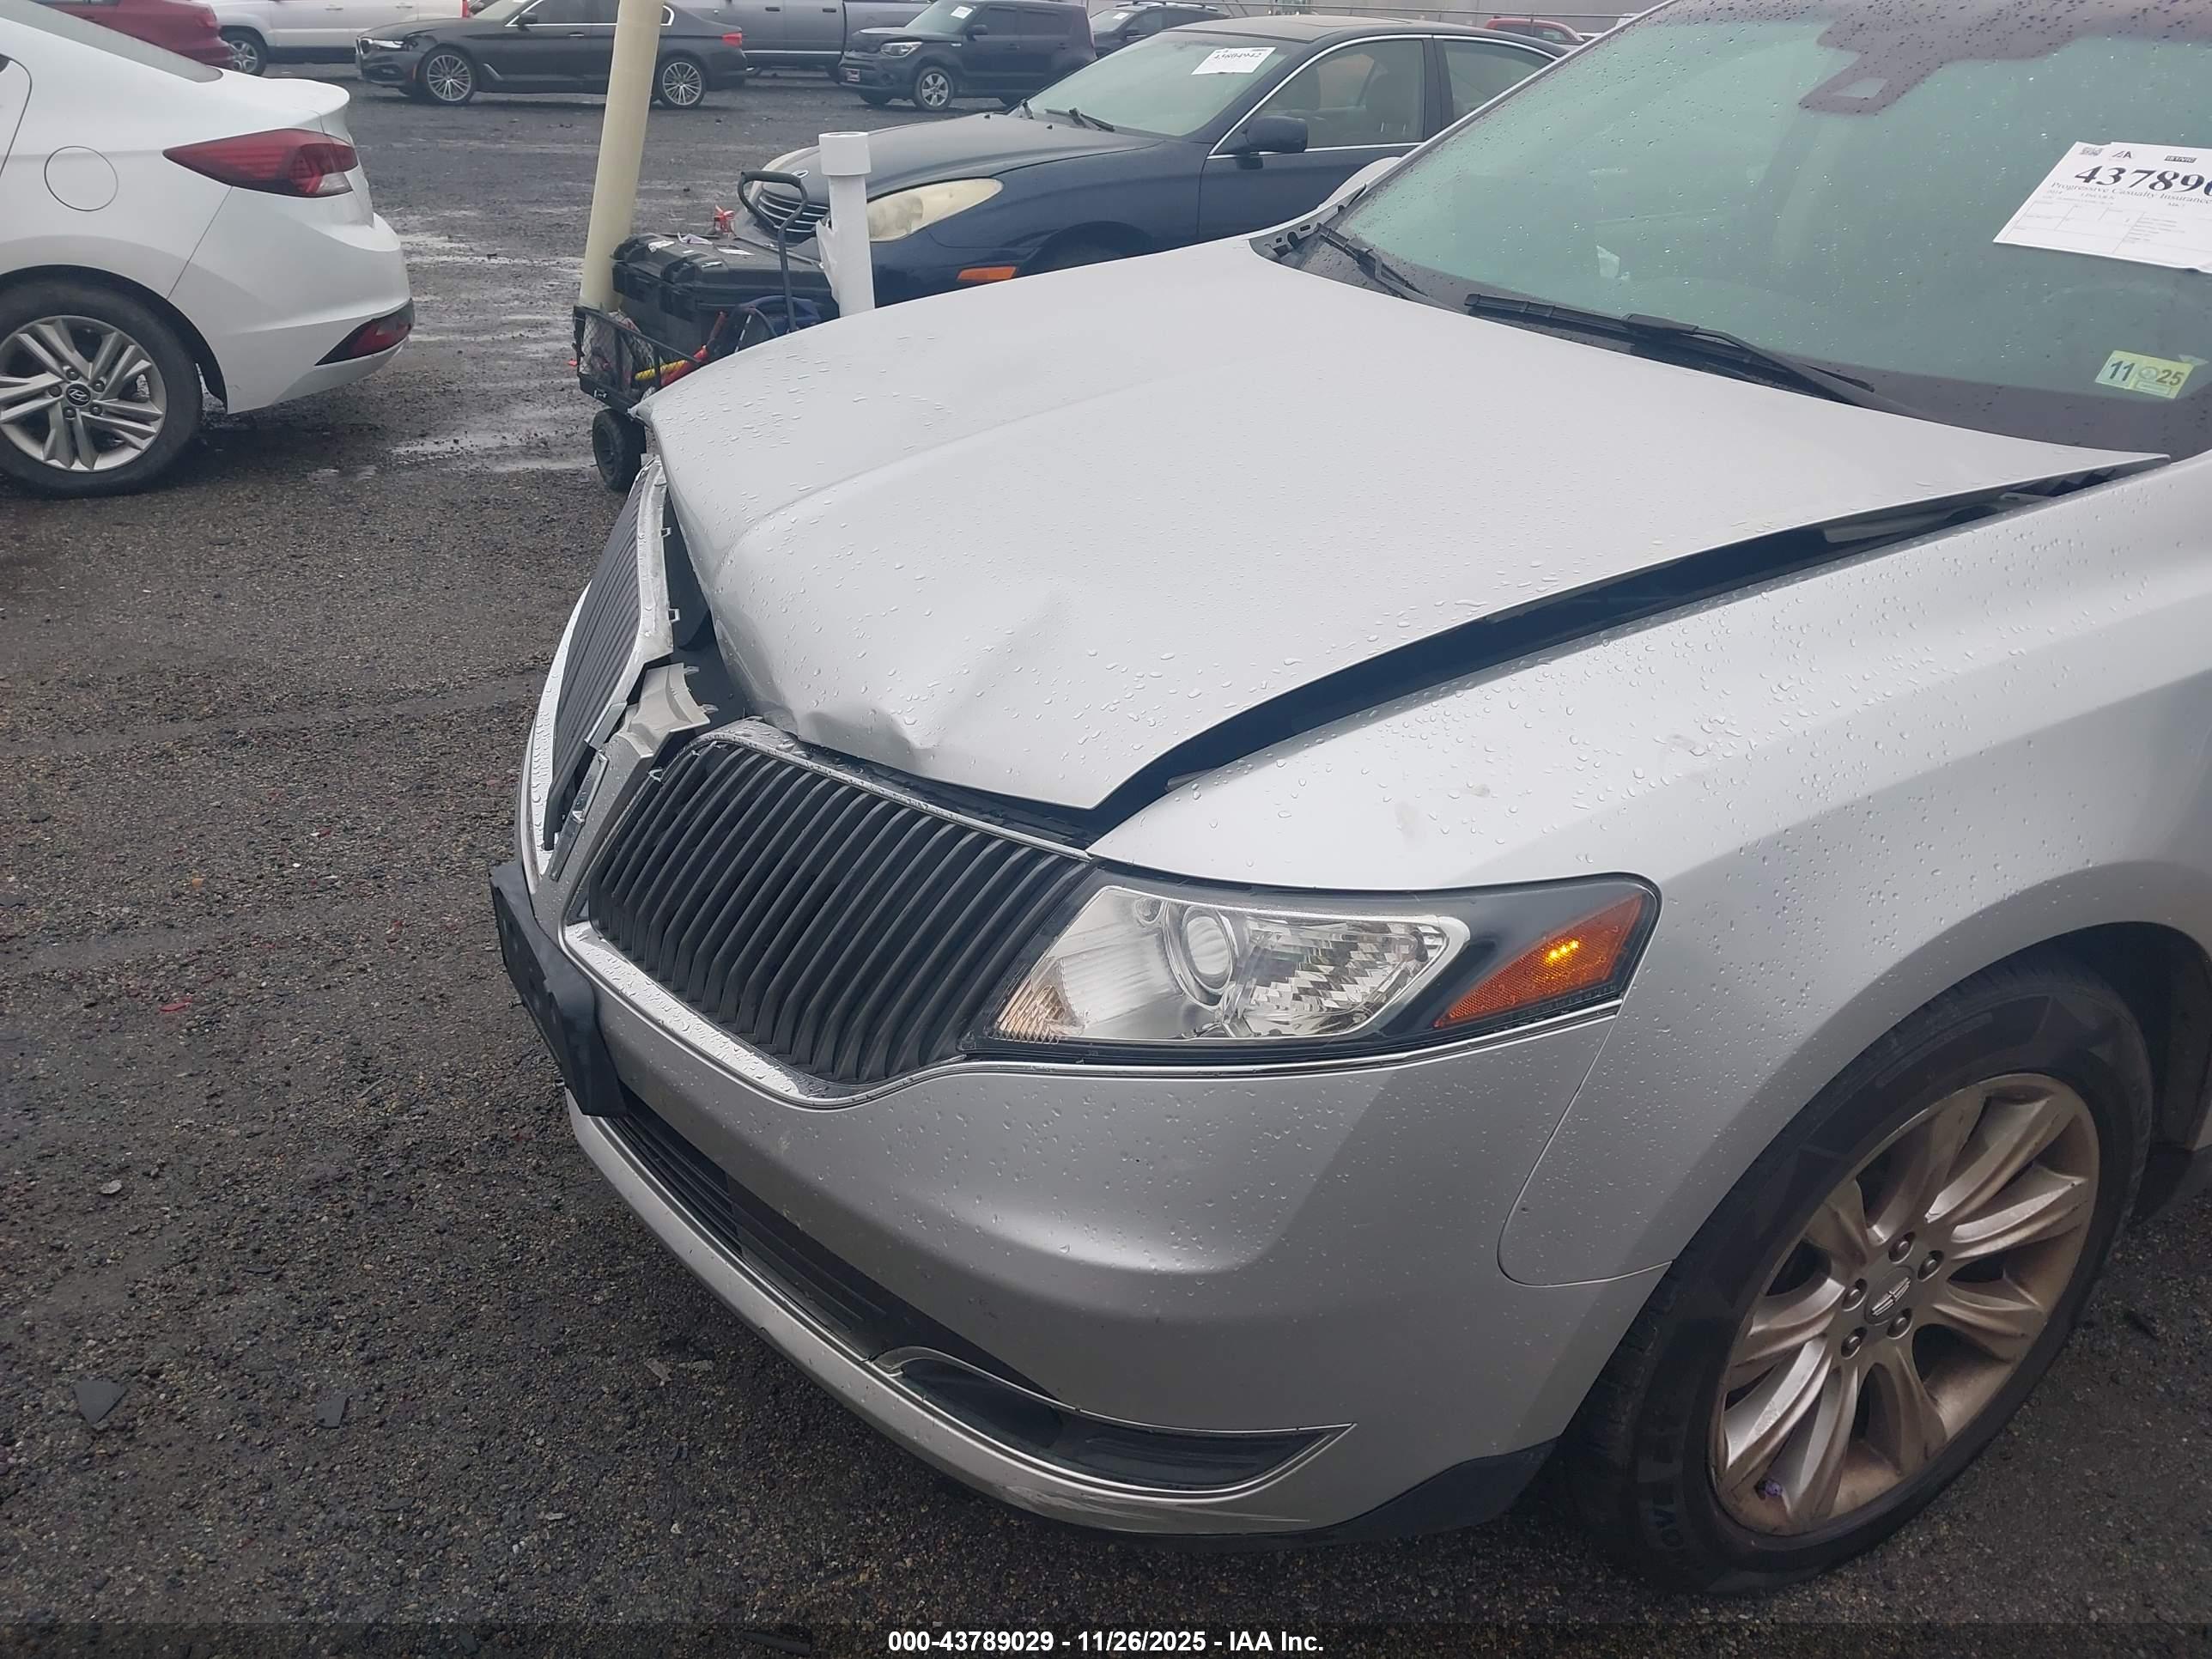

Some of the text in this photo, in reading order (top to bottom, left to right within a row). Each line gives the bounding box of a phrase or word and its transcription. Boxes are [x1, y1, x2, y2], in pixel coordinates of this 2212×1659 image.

[2051, 182, 2110, 193] Progressive
[2112, 188, 2155, 198] Casualty
[2110, 361, 2136, 382] 11
[2156, 368, 2185, 386] 25
